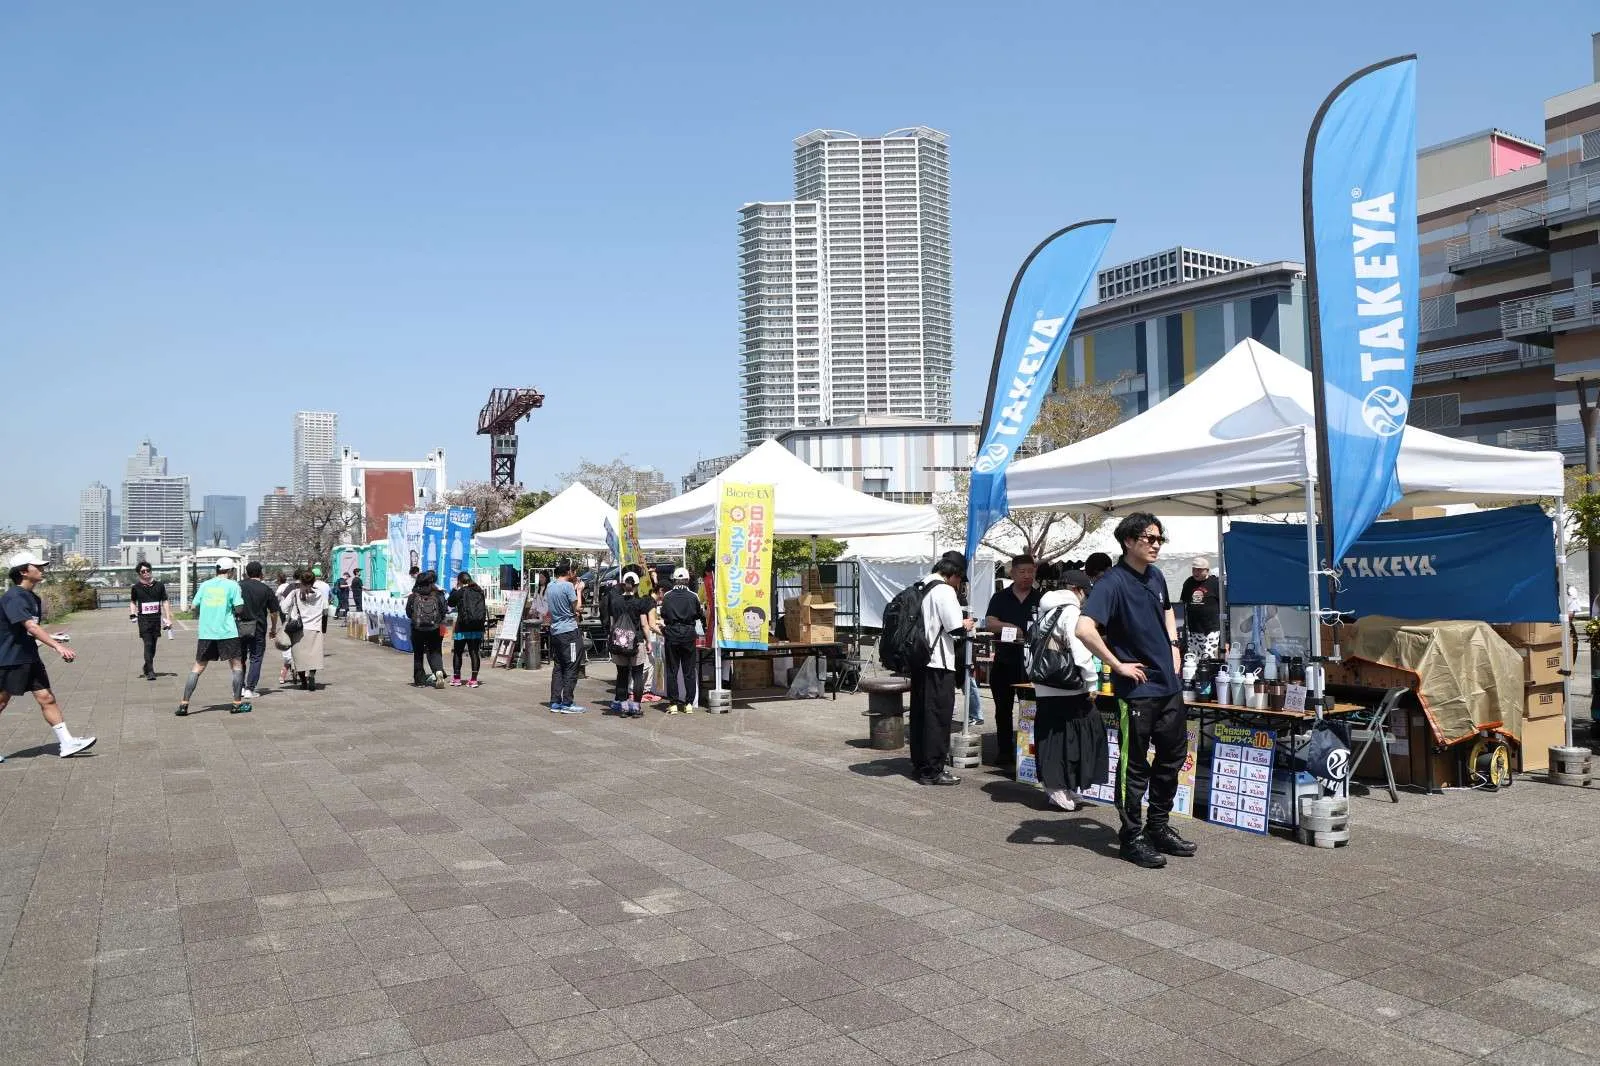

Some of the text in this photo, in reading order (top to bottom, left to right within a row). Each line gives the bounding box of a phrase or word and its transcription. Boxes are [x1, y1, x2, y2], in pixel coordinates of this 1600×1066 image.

[1352, 191, 1405, 382] TAKEYA
[993, 317, 1065, 436] TAKEYA
[727, 526, 745, 608] ステーション
[744, 505, 764, 586] 日焼け止め
[1343, 555, 1437, 578] TAKEYA
